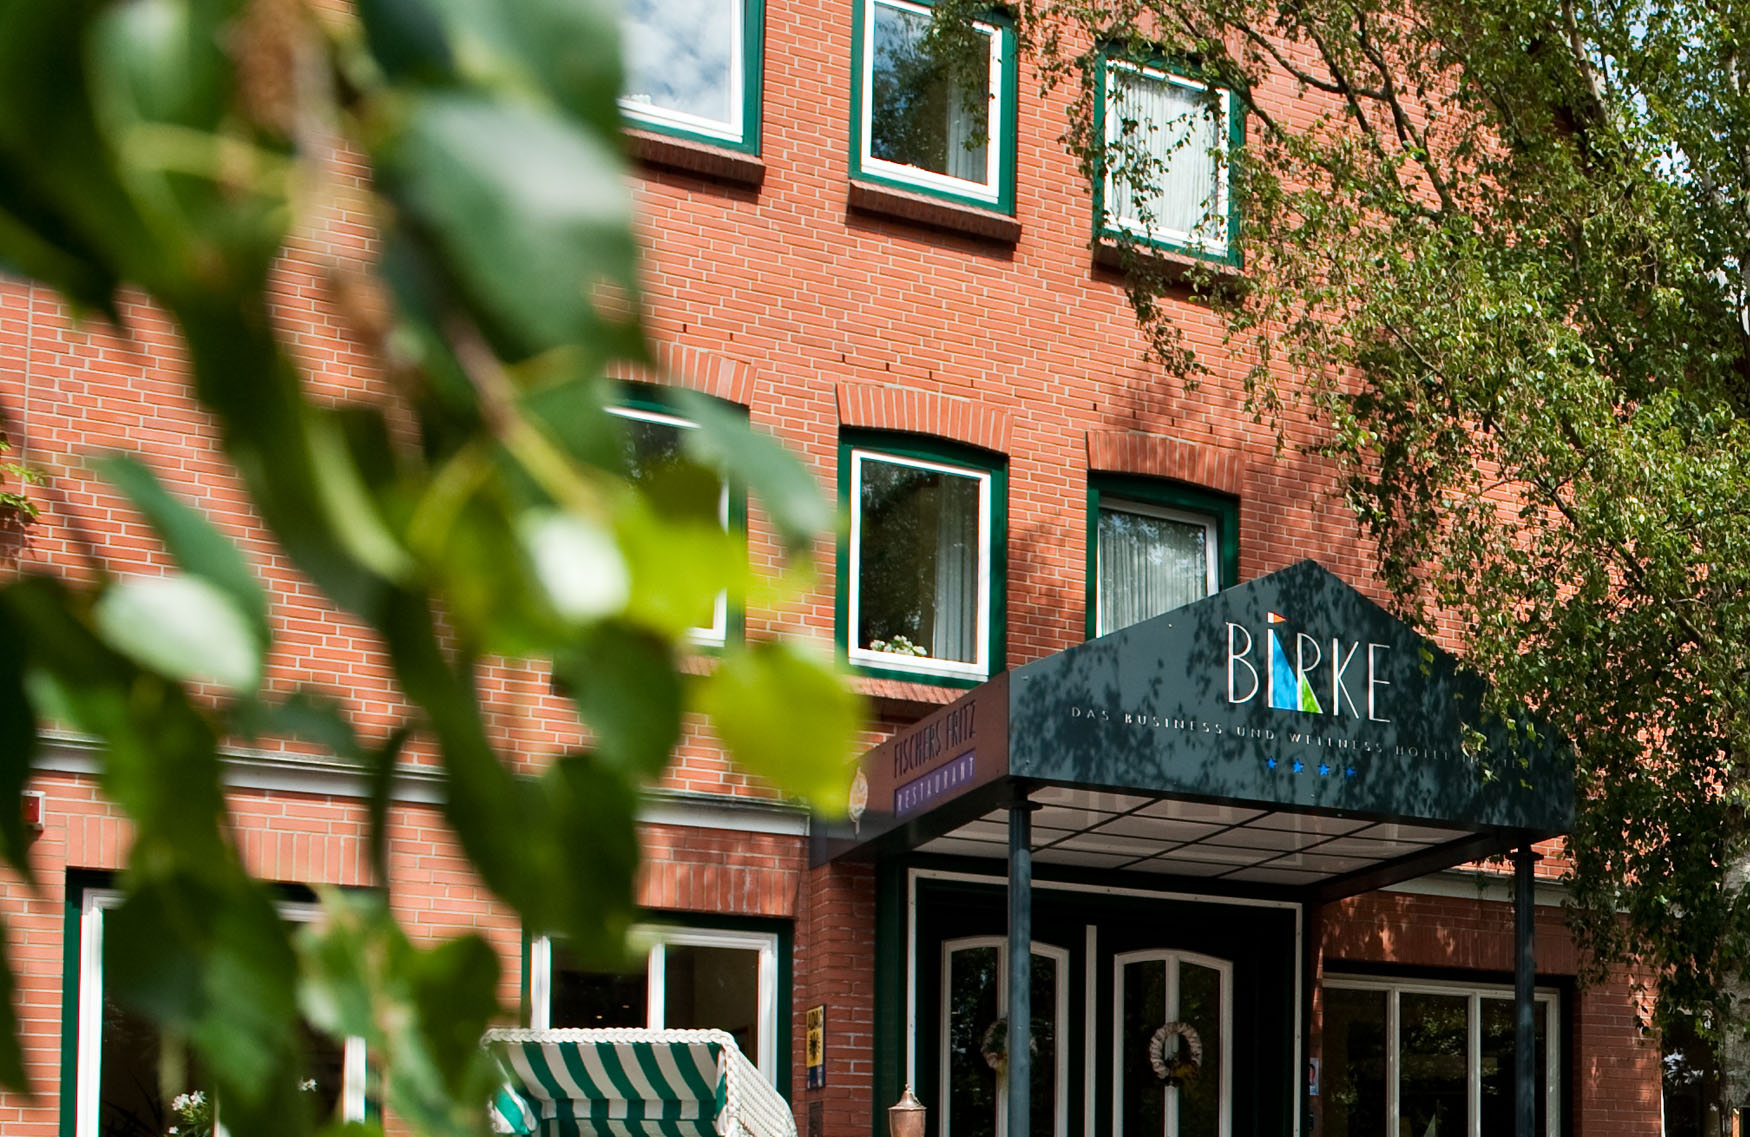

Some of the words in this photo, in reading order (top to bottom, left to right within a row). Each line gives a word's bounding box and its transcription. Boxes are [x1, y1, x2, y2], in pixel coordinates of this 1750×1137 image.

[894, 720, 941, 779] FISCHERS
[946, 699, 977, 751] FRITZ
[1071, 707, 1110, 721] DAS
[1125, 713, 1223, 735] BUSINESS
[1236, 726, 1275, 740] UND
[897, 756, 975, 812] RESTAURANT
